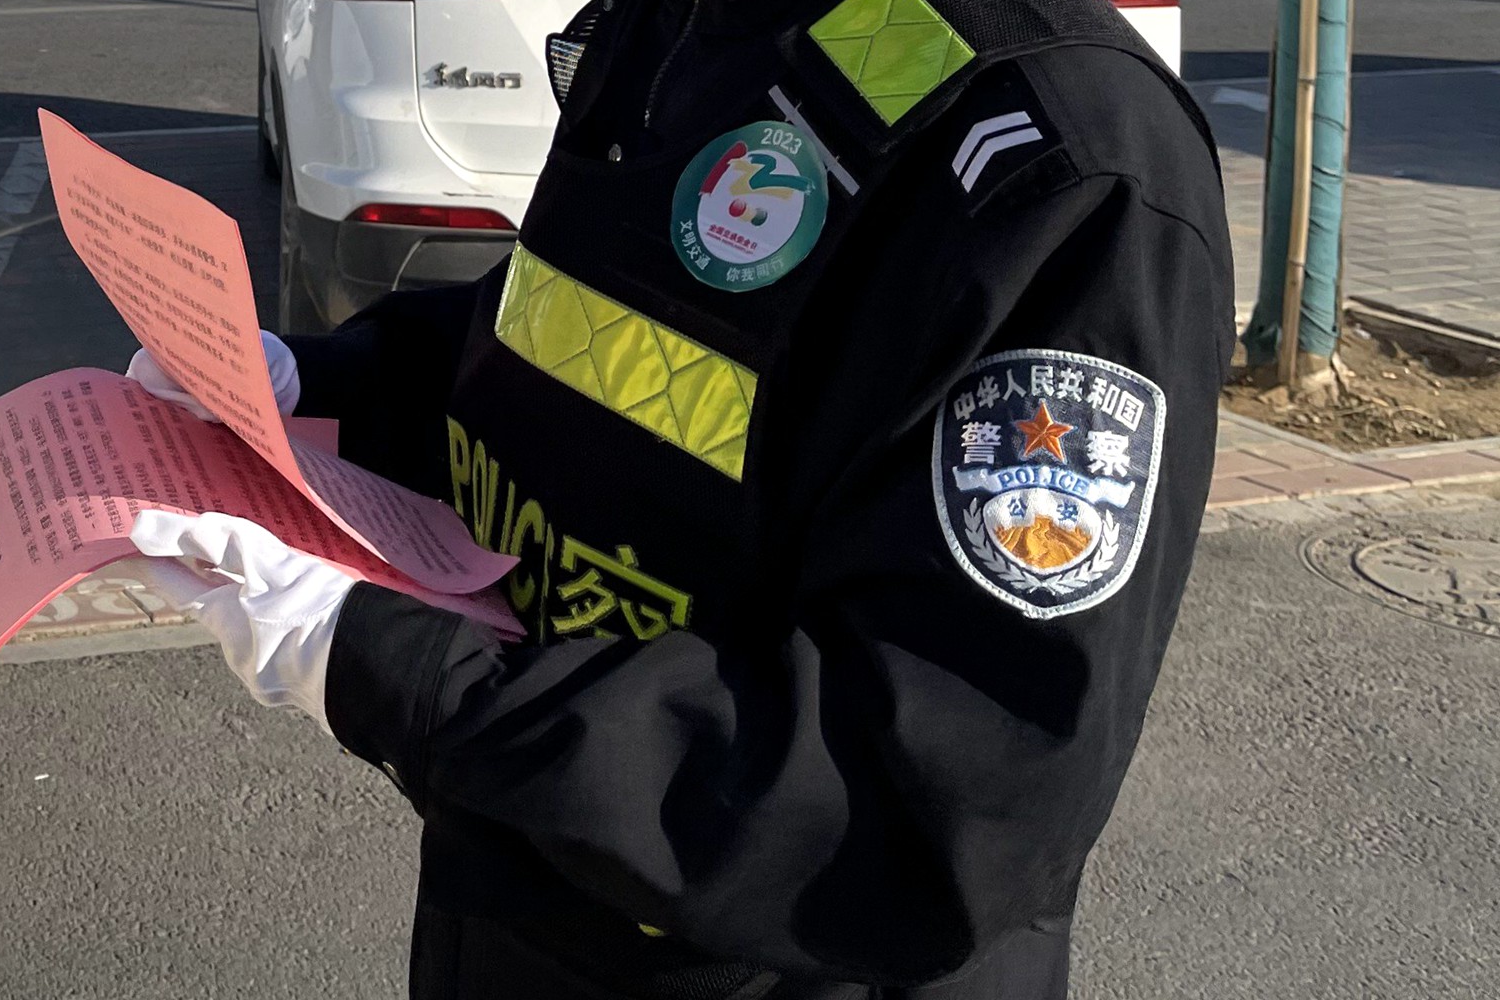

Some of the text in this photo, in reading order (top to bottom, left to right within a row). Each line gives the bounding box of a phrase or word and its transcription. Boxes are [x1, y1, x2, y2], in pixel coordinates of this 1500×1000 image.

[761, 127, 802, 155] 2023
[679, 219, 712, 270] 文明交通
[726, 257, 785, 282] 你我同行
[953, 365, 1145, 432] 中华人民共和国
[1000, 465, 1092, 494] POLICE
